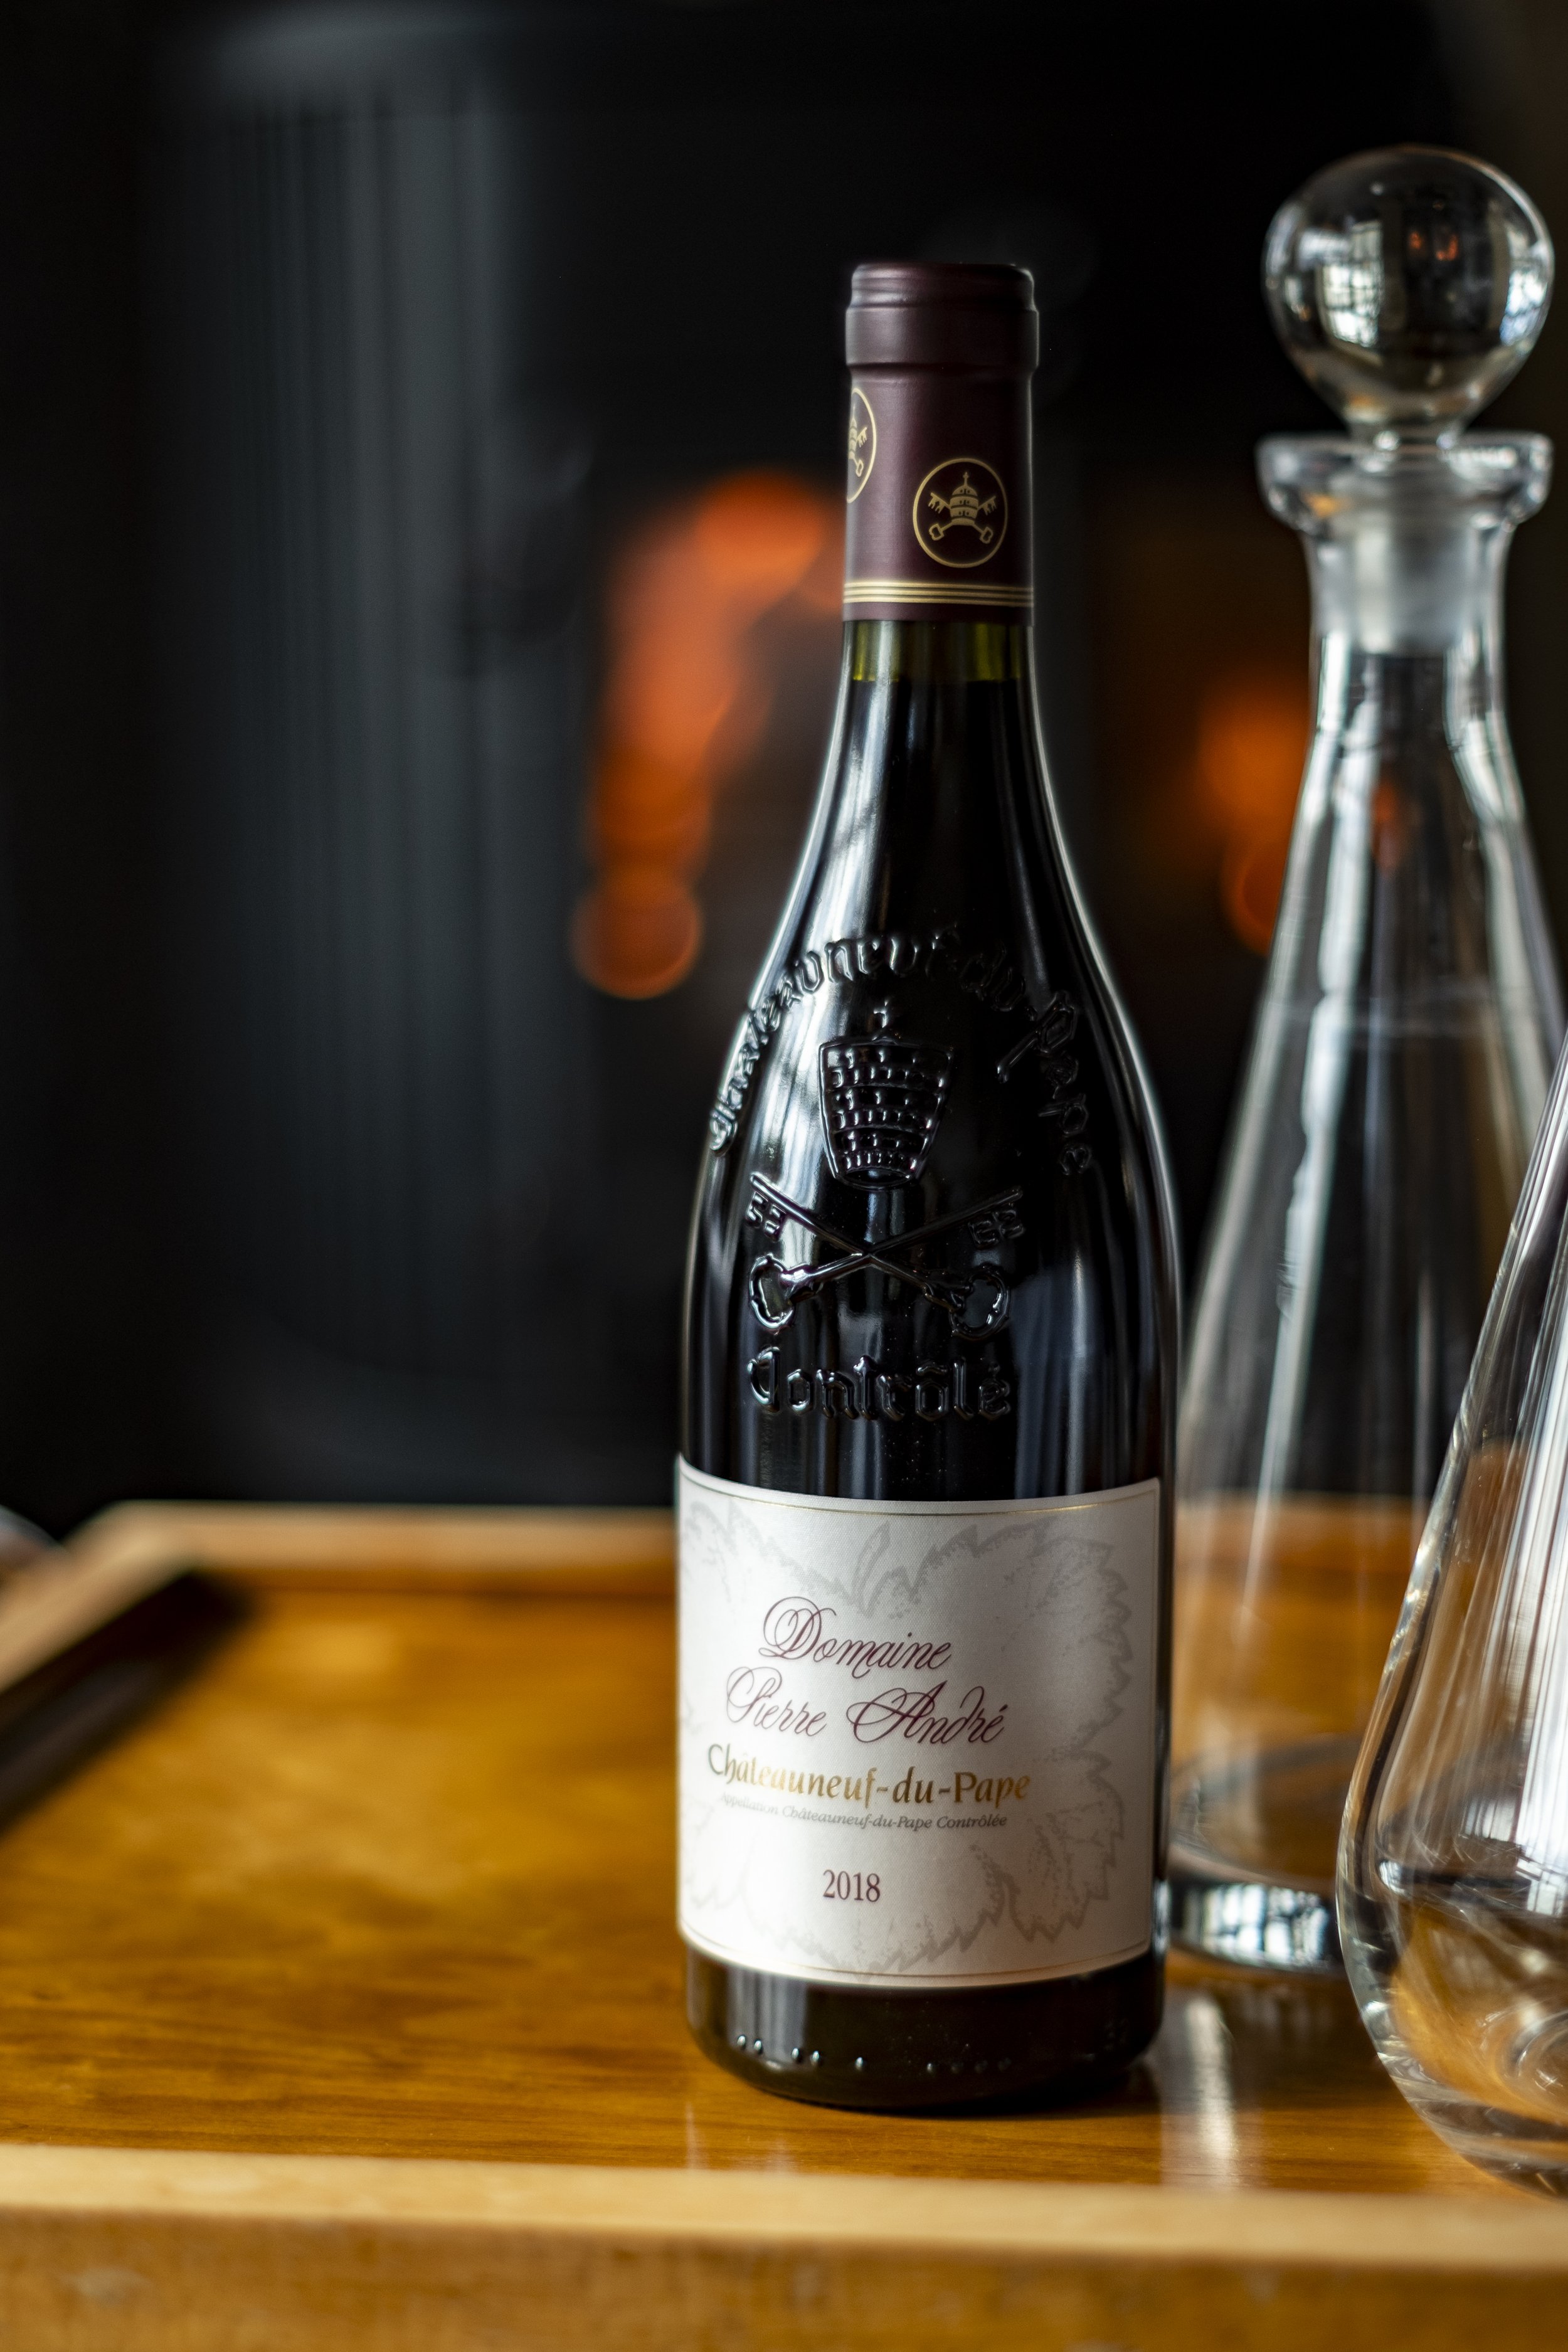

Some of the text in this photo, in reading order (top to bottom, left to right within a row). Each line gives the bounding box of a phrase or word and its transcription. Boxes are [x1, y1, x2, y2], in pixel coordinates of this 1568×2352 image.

[758, 1596, 952, 1678] Domaine
[726, 1666, 1008, 1744] Pierre André
[707, 1743, 1030, 1809] Châteauneuf-du-Pape
[781, 1804, 933, 1831] Châteauneuf-du-Pape
[936, 1814, 1007, 1829] Contrôlée
[822, 1869, 881, 1902] 2018
